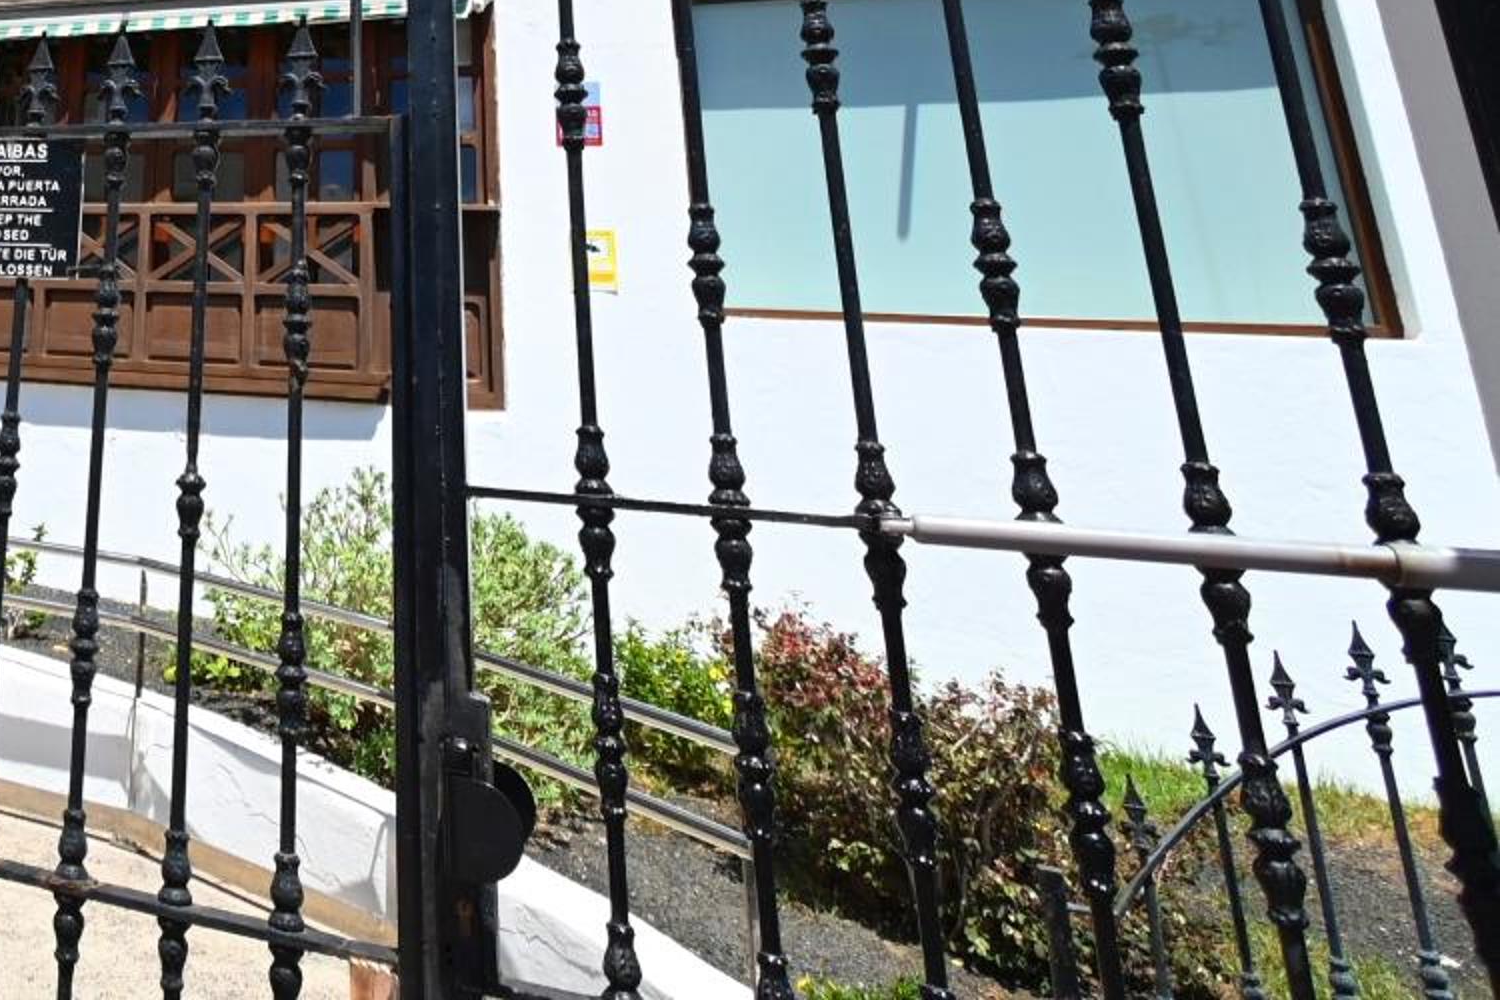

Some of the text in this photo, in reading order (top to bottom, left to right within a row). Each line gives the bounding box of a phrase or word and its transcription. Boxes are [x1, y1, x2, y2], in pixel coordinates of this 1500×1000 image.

[8, 180, 60, 192] PUERTA
[17, 213, 42, 226] THE
[14, 248, 35, 260] DIE
[40, 247, 67, 262] TÜR
